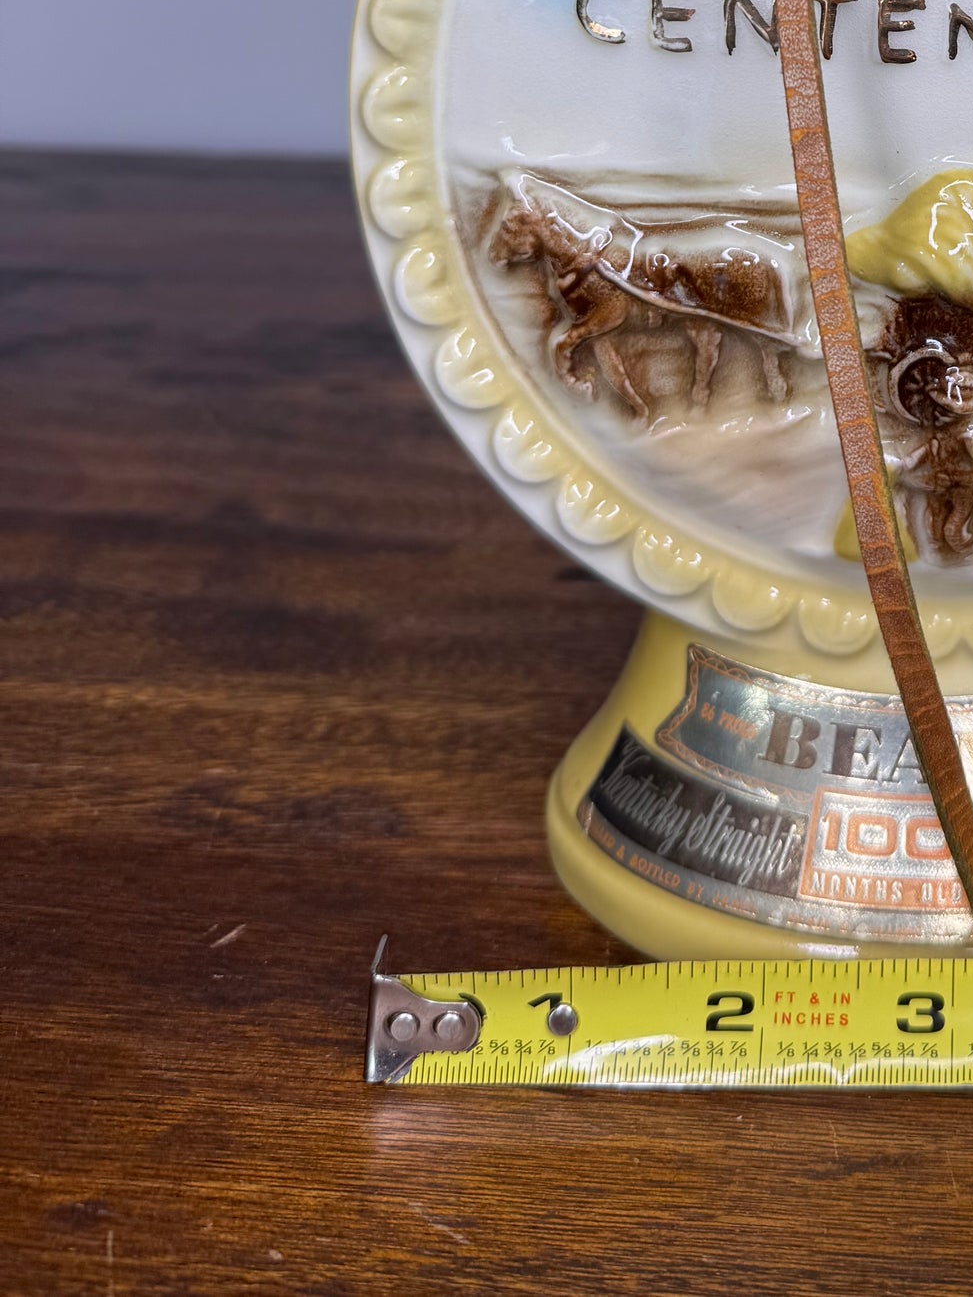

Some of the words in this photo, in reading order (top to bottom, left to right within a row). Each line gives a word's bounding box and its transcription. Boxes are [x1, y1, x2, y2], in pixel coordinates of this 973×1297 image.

[701, 703, 715, 722] 86
[680, 791, 798, 885] Straight
[821, 808, 951, 861] 100
[629, 853, 681, 889] BOTTLED
[811, 871, 903, 903] MONTHS
[921, 882, 964, 904] OLD
[706, 991, 755, 1032] 2
[896, 991, 945, 1033] 3
[775, 992, 795, 1005] FT
[809, 992, 819, 1005] &
[833, 993, 850, 1005] IN
[773, 1012, 849, 1026] INCHES
[489, 1040, 509, 1055] 5/8
[515, 1040, 532, 1055] 3/4
[538, 1040, 556, 1055] 7/8
[657, 1041, 675, 1056] 1/2
[681, 1041, 701, 1057] 5/8
[706, 1041, 724, 1057] 3/4
[729, 1041, 747, 1057] 7/8
[777, 1042, 795, 1058] 1/8
[802, 1042, 819, 1058] 1/4
[824, 1042, 842, 1058] 3/8
[848, 1042, 866, 1058] 1/2
[872, 1043, 892, 1058] 5/8
[897, 1043, 915, 1058] 3/4
[919, 1043, 938, 1058] 7/8
